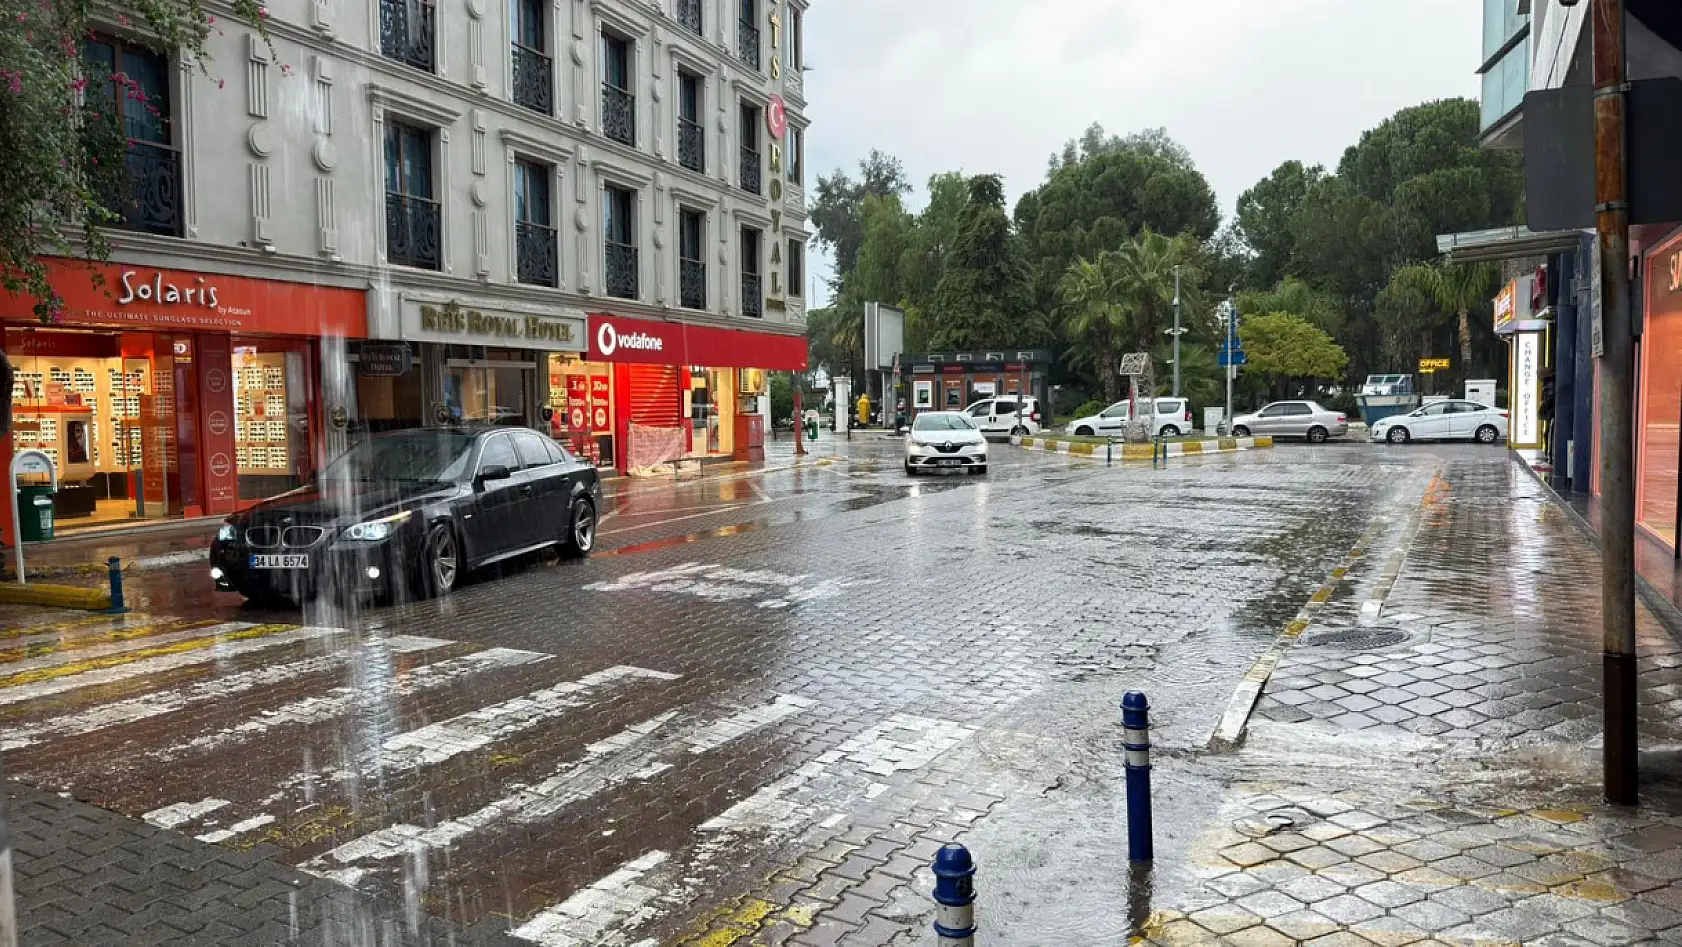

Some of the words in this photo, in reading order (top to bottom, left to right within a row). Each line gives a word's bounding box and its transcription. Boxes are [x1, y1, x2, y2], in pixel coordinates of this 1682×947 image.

[769, 143, 783, 295] ROYAL
[119, 271, 218, 308] Solaris
[86, 310, 102, 318] THE
[106, 311, 149, 321] ULTIMATE
[153, 314, 196, 324] SUNGLASS
[199, 317, 242, 326] SELECTION
[218, 305, 227, 316] by
[467, 310, 523, 338] ROYAL
[524, 315, 576, 342] HOTEL
[617, 331, 663, 351] vodafone
[1524, 342, 1532, 386] CHANGE
[1523, 393, 1531, 436] OFFICE
[256, 555, 265, 567] 34
[284, 555, 308, 567] 6574
